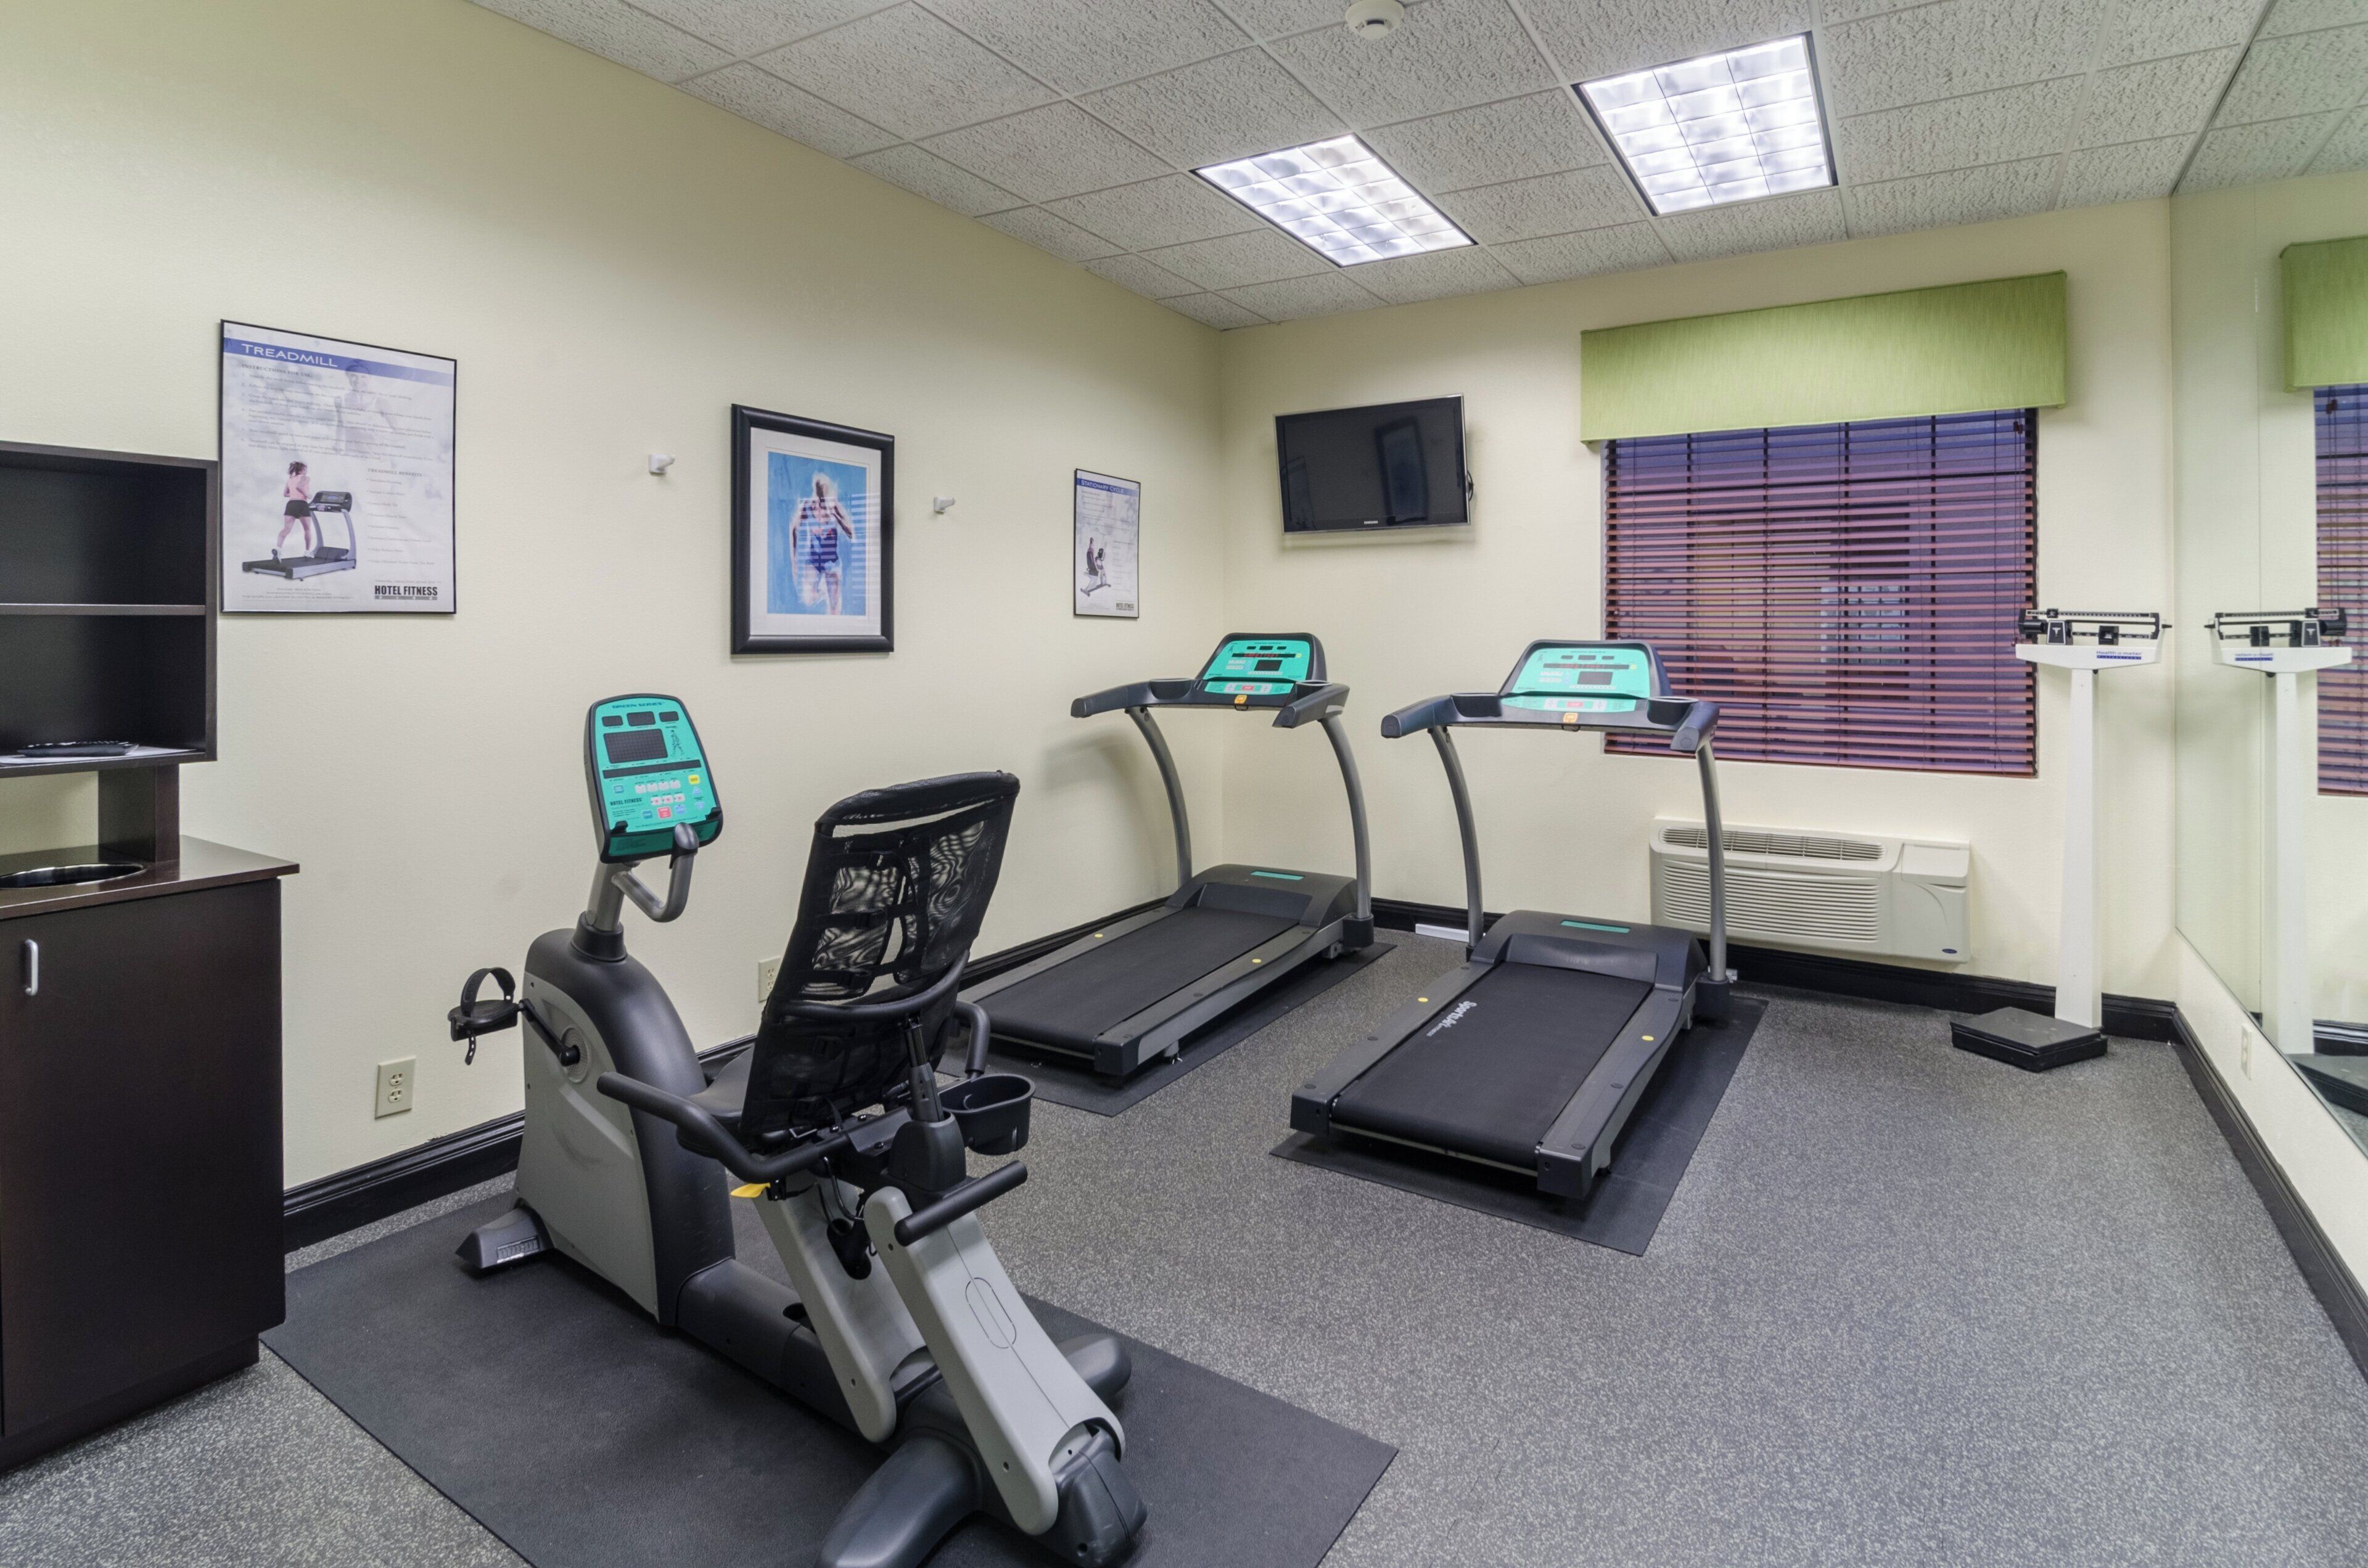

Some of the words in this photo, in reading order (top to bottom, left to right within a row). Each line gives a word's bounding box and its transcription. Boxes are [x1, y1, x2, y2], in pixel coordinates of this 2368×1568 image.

[240, 343, 338, 368] TREADMILL
[242, 363, 287, 374] INSTRUCTIONS
[1081, 480, 1109, 490] STATIONARY
[374, 585, 401, 595] HOTEL
[403, 586, 438, 596] FITNESS
